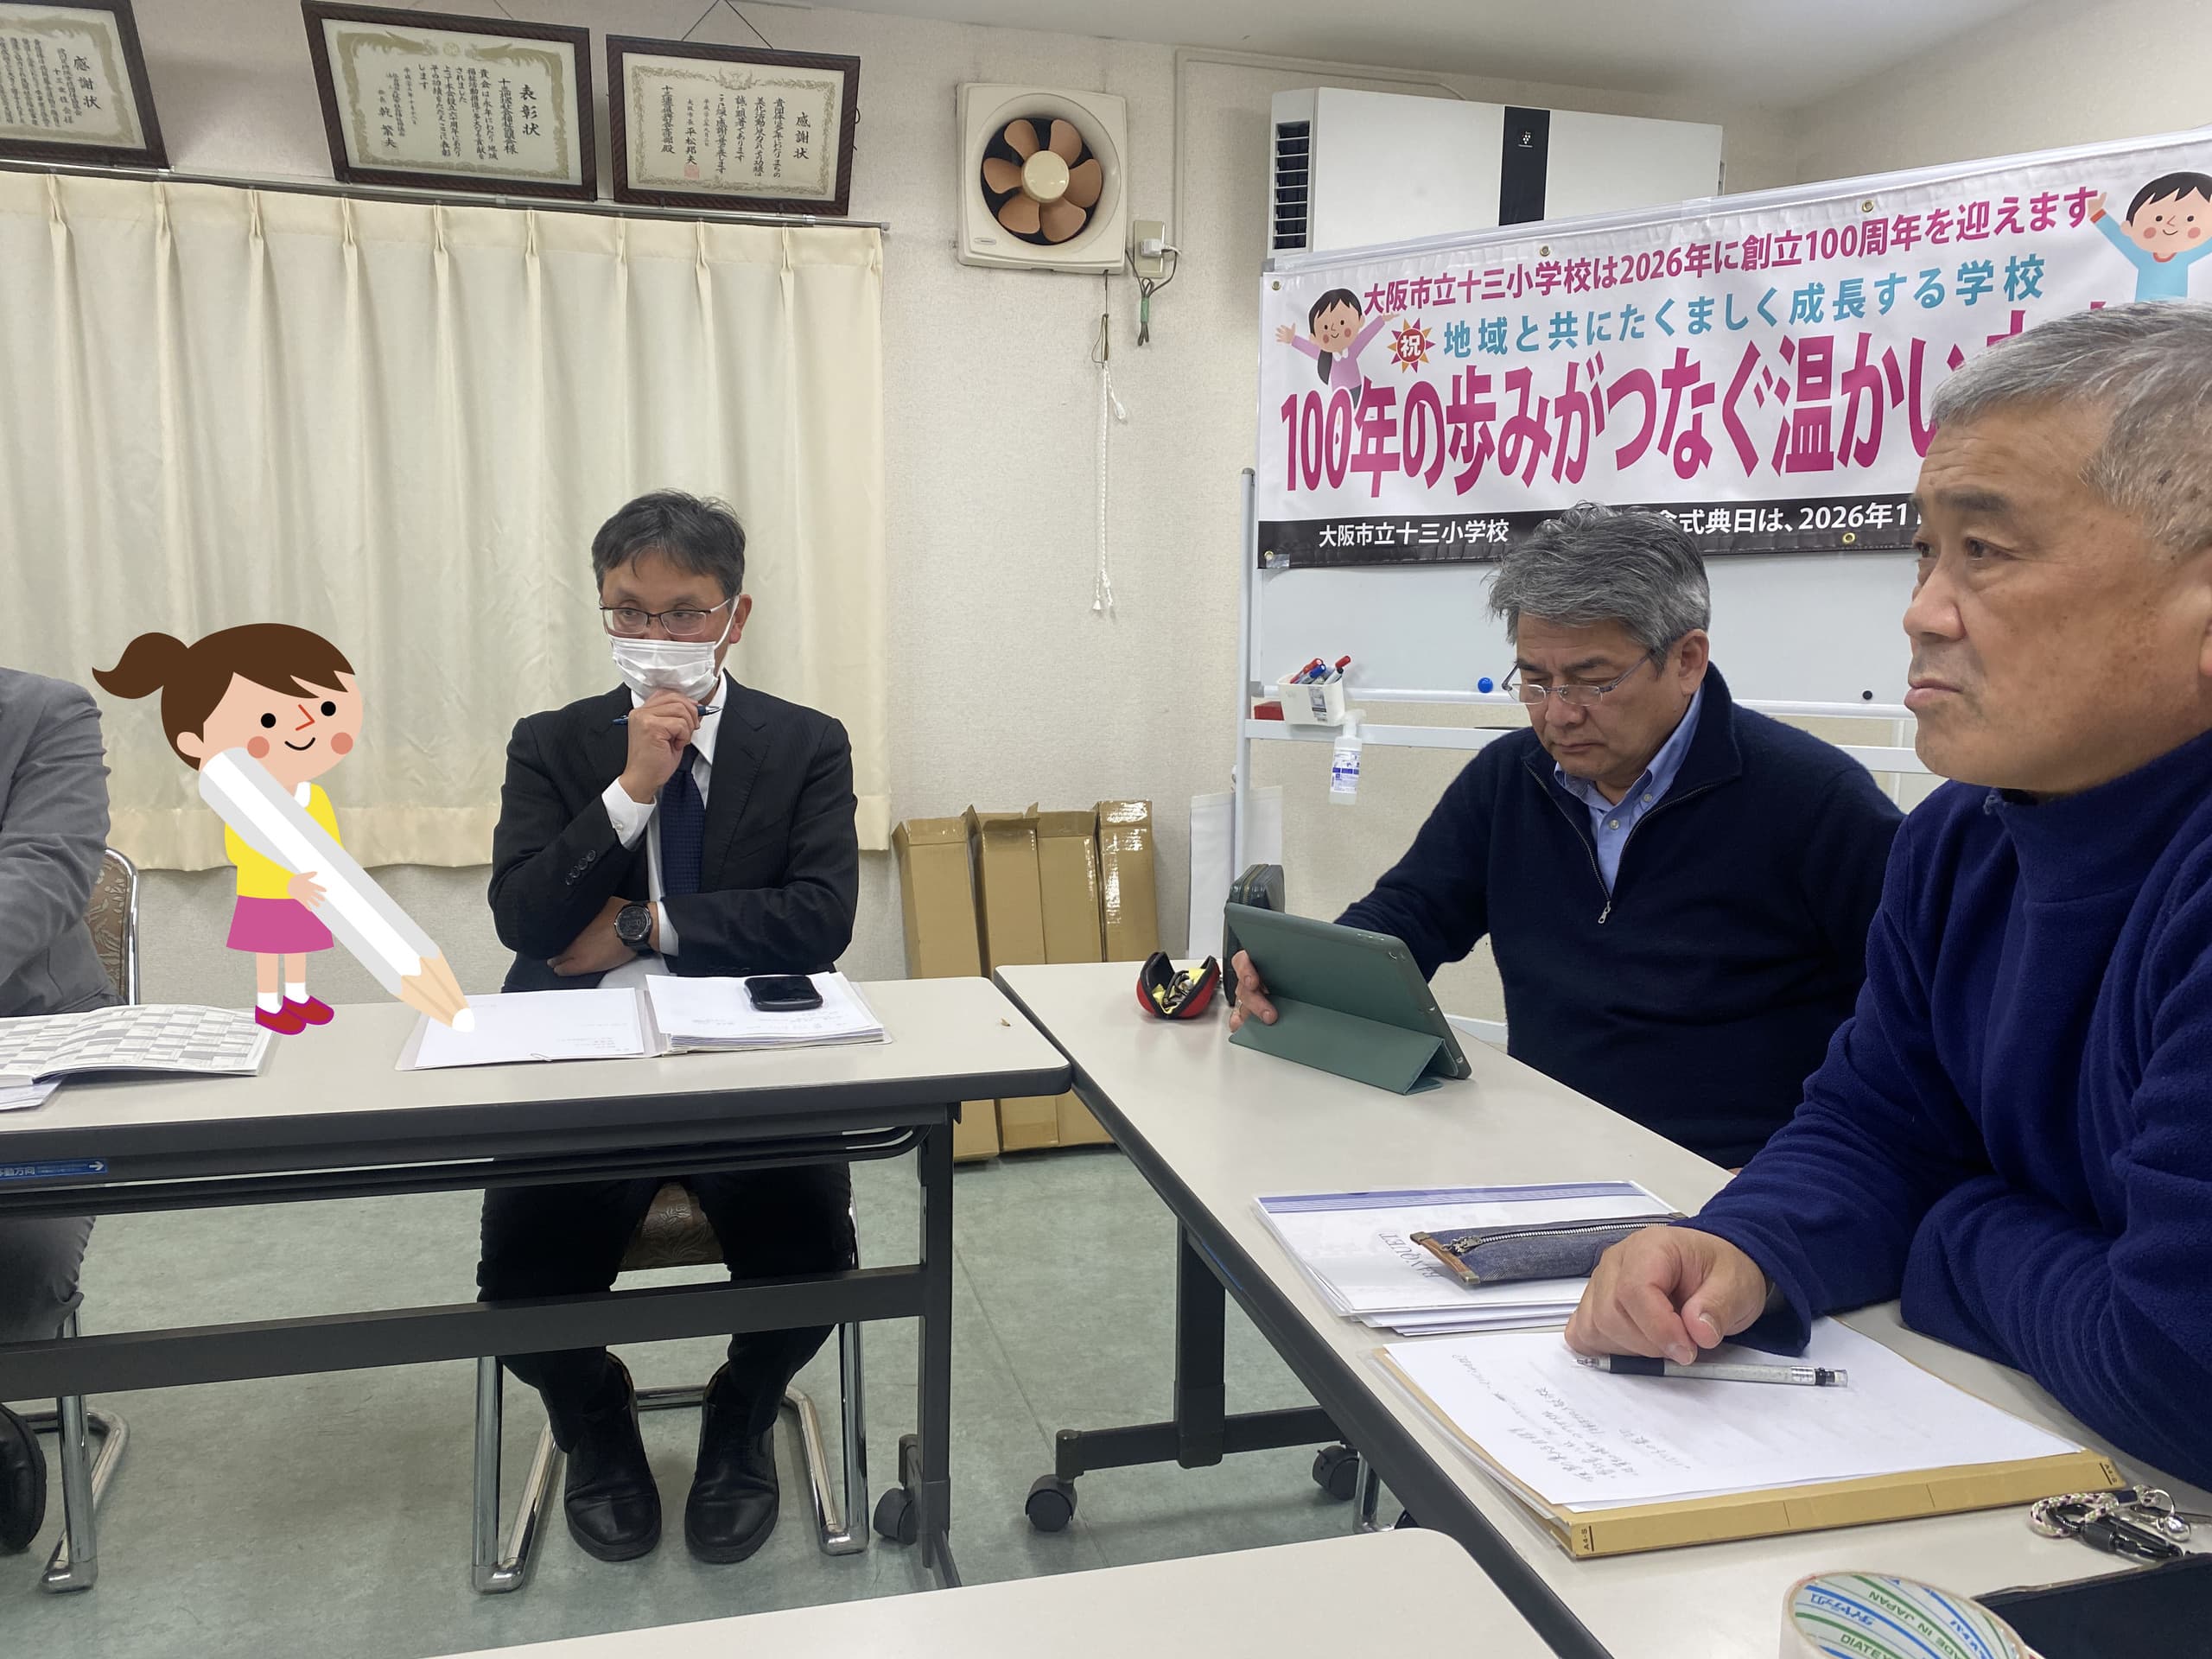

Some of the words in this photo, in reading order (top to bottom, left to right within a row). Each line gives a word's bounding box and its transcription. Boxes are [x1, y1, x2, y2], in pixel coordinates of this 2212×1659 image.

[73, 55, 102, 111] 感謝状
[518, 84, 541, 137] 表彰状
[793, 111, 811, 160] 感謝状
[1363, 186, 2098, 315] 大阪市立十三小学校は2026年に創立100周年を迎えます
[1443, 253, 2045, 359] 地域と共にたくましく成長する学校
[1400, 334, 1421, 358] 祝
[1281, 301, 2107, 499] 100年の歩みがつなぐ温かい
[1319, 518, 1510, 547] 大阪市立十三小学校
[1868, 1591, 1916, 1621] JAPAN
